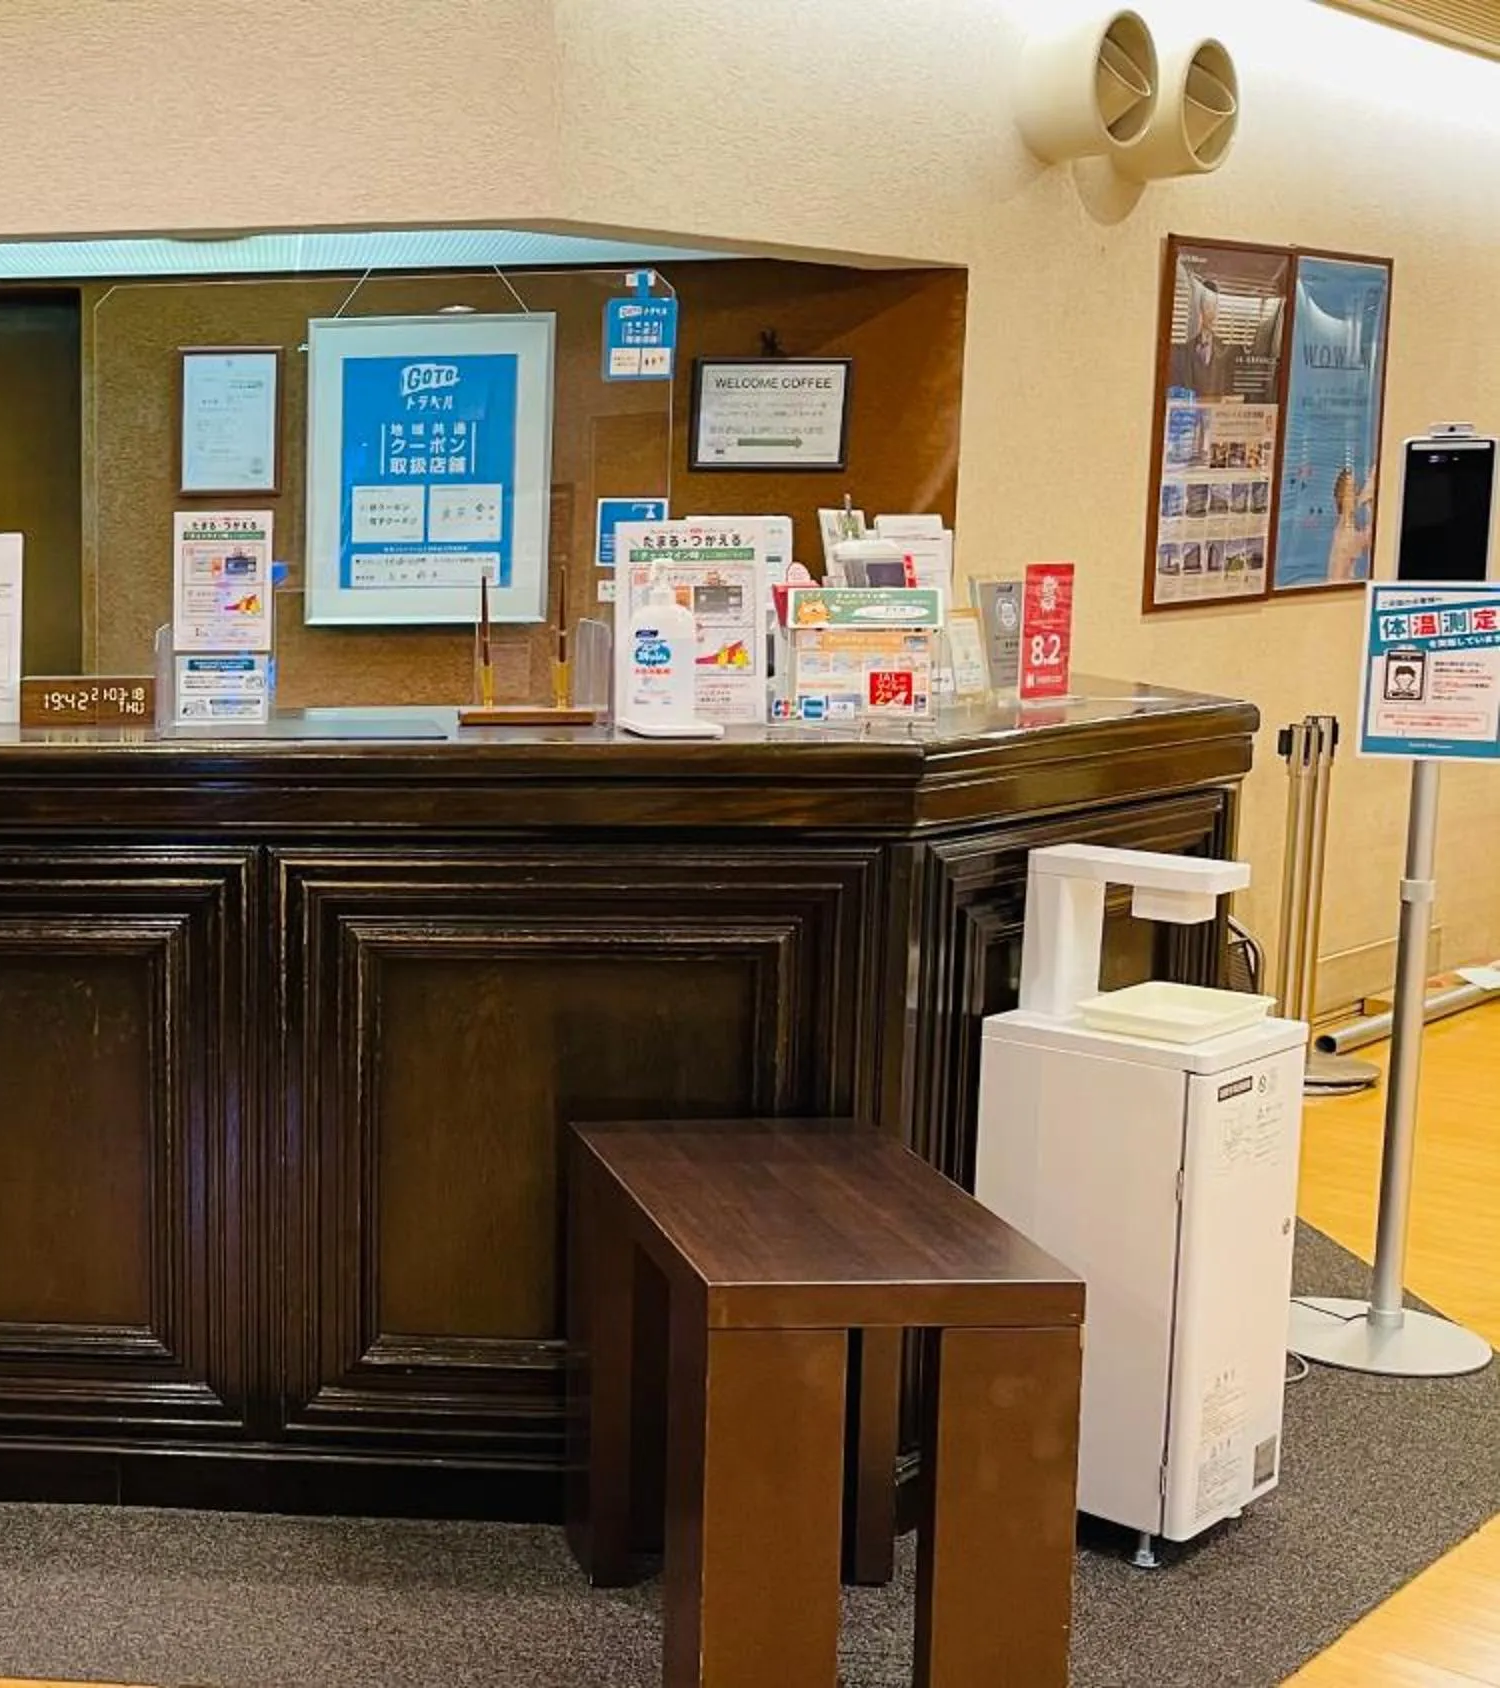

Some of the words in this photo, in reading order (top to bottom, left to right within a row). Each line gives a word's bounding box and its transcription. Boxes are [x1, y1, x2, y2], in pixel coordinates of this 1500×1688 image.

[714, 377, 778, 389] WELCOME
[781, 377, 833, 389] COFFEE
[405, 396, 453, 411] トラベル
[391, 437, 466, 455] クーポン
[389, 457, 467, 474] 取扱店舗
[1382, 609, 1498, 639] 体温測定
[1031, 634, 1061, 667] 8.2
[44, 692, 89, 711] 19:42
[118, 701, 145, 715] THU
